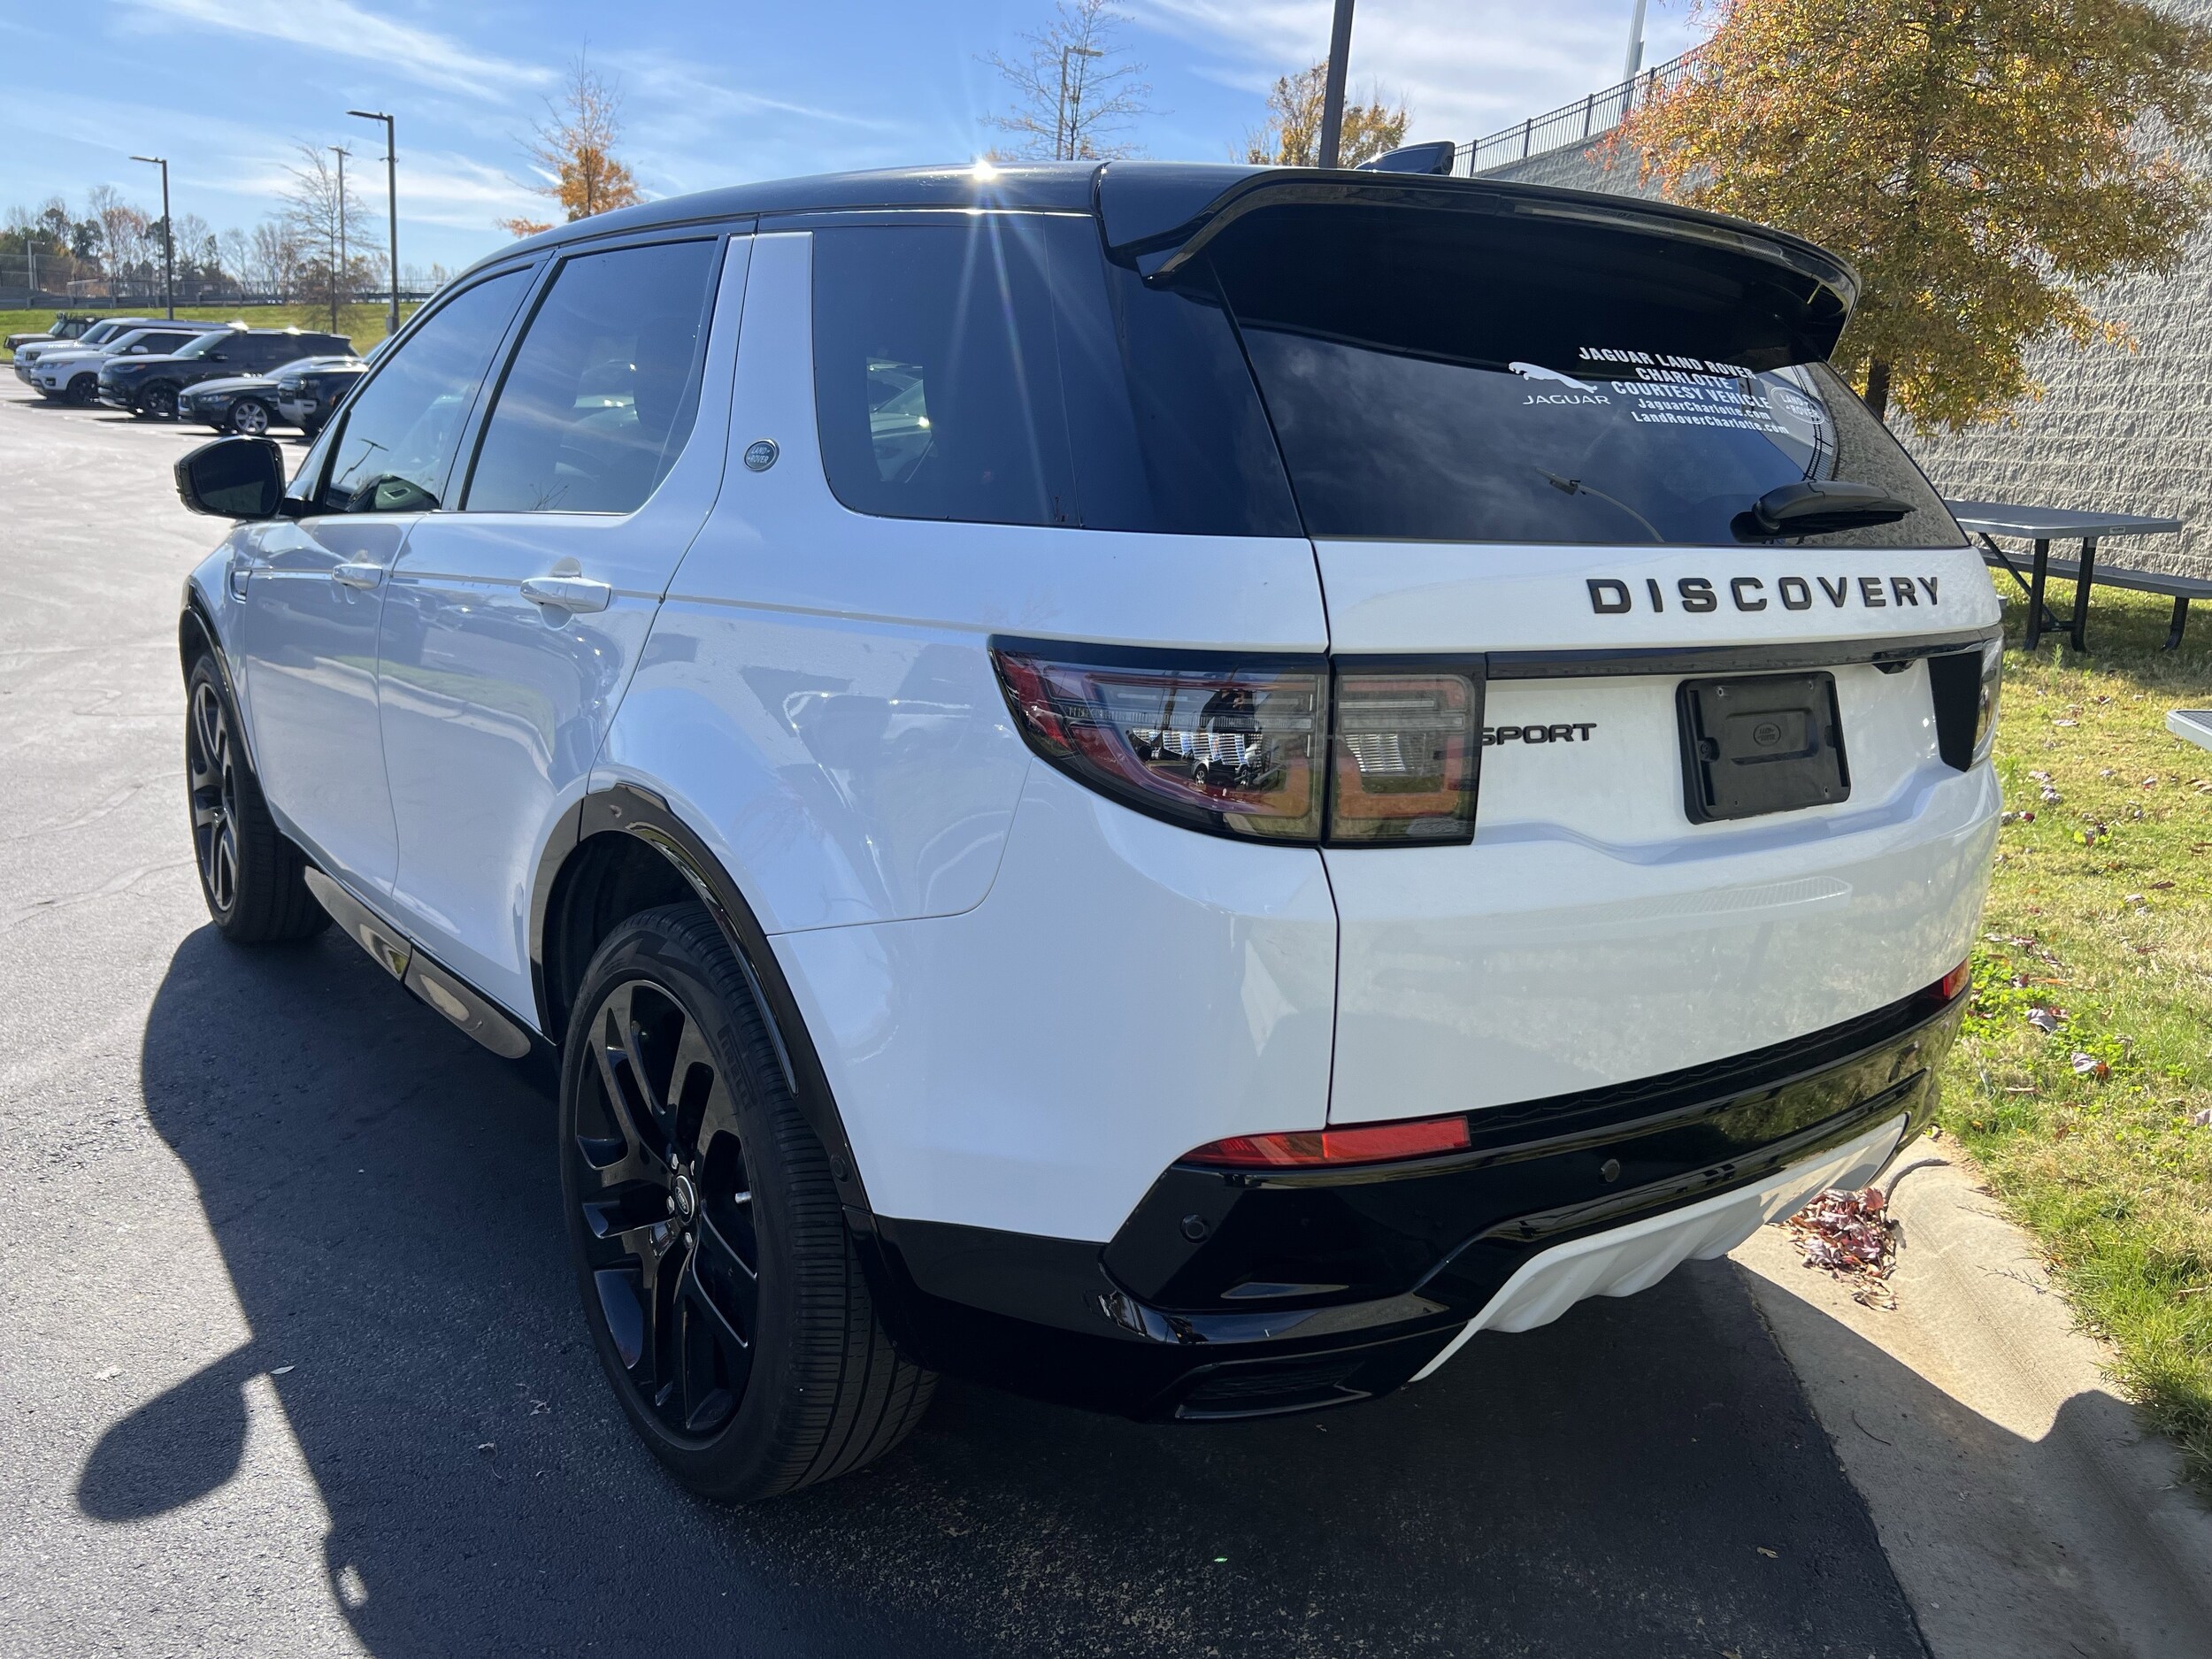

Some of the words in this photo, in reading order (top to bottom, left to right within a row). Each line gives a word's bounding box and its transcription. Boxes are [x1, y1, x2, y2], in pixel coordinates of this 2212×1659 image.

[1578, 347, 1655, 365] JAGUAR
[1655, 354, 1704, 371] LAND
[1703, 360, 1757, 380] ROVER
[1634, 367, 1733, 389] CHARLOTTE
[1522, 395, 1611, 405] JAGUAR
[1610, 381, 1704, 400] COURTESY
[1704, 389, 1773, 410] VEHICLE
[1779, 394, 1804, 406] LAND
[1638, 398, 1771, 420] JaguarCharlotte.com
[1631, 411, 1789, 434] LandRoverCharlotte.com
[1586, 576, 1939, 614] DISCOVERY
